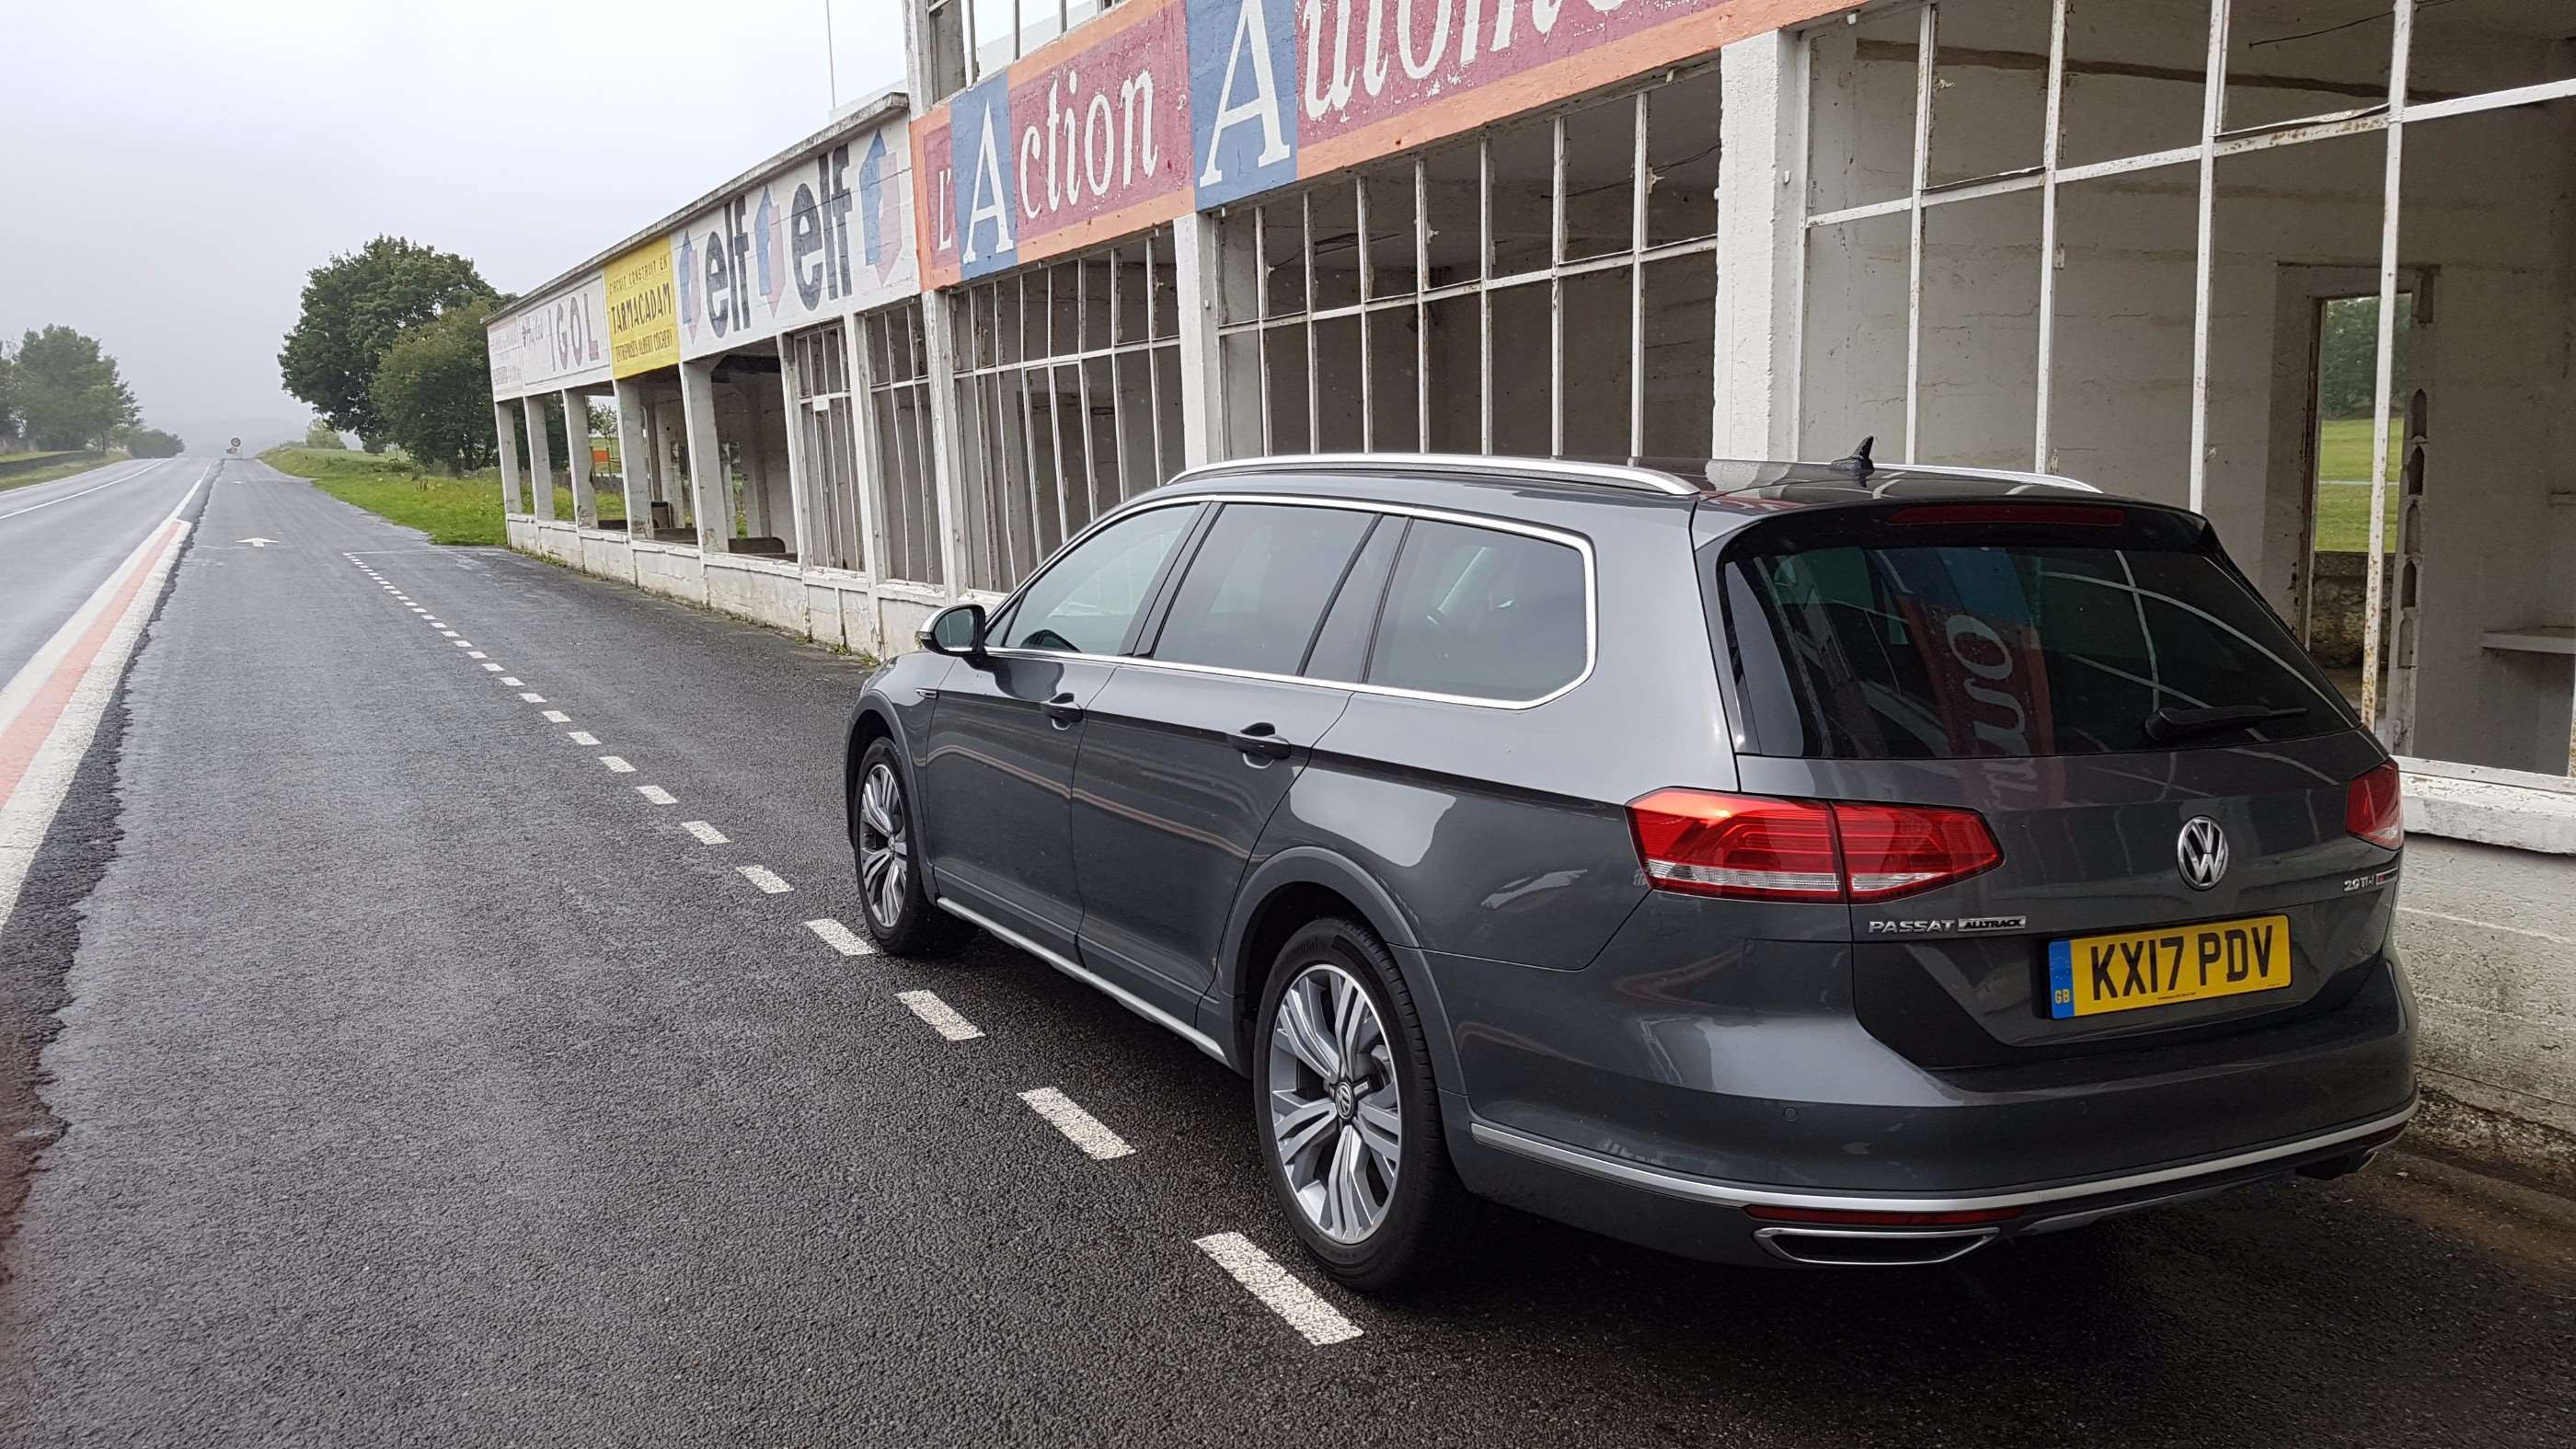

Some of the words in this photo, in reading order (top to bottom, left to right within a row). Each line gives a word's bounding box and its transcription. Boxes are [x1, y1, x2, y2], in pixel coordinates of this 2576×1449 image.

[791, 143, 854, 312] elf
[660, 254, 669, 271] EN
[705, 194, 752, 339] elf
[547, 293, 600, 372] IGOL
[611, 282, 673, 336] TARMACADAM
[1868, 919, 1956, 934] PASSAT
[1962, 918, 2022, 930] ALLTRACK
[2089, 936, 2185, 1001] KX17
[2197, 924, 2273, 987] PDV
[2053, 988, 2071, 1006] GB
